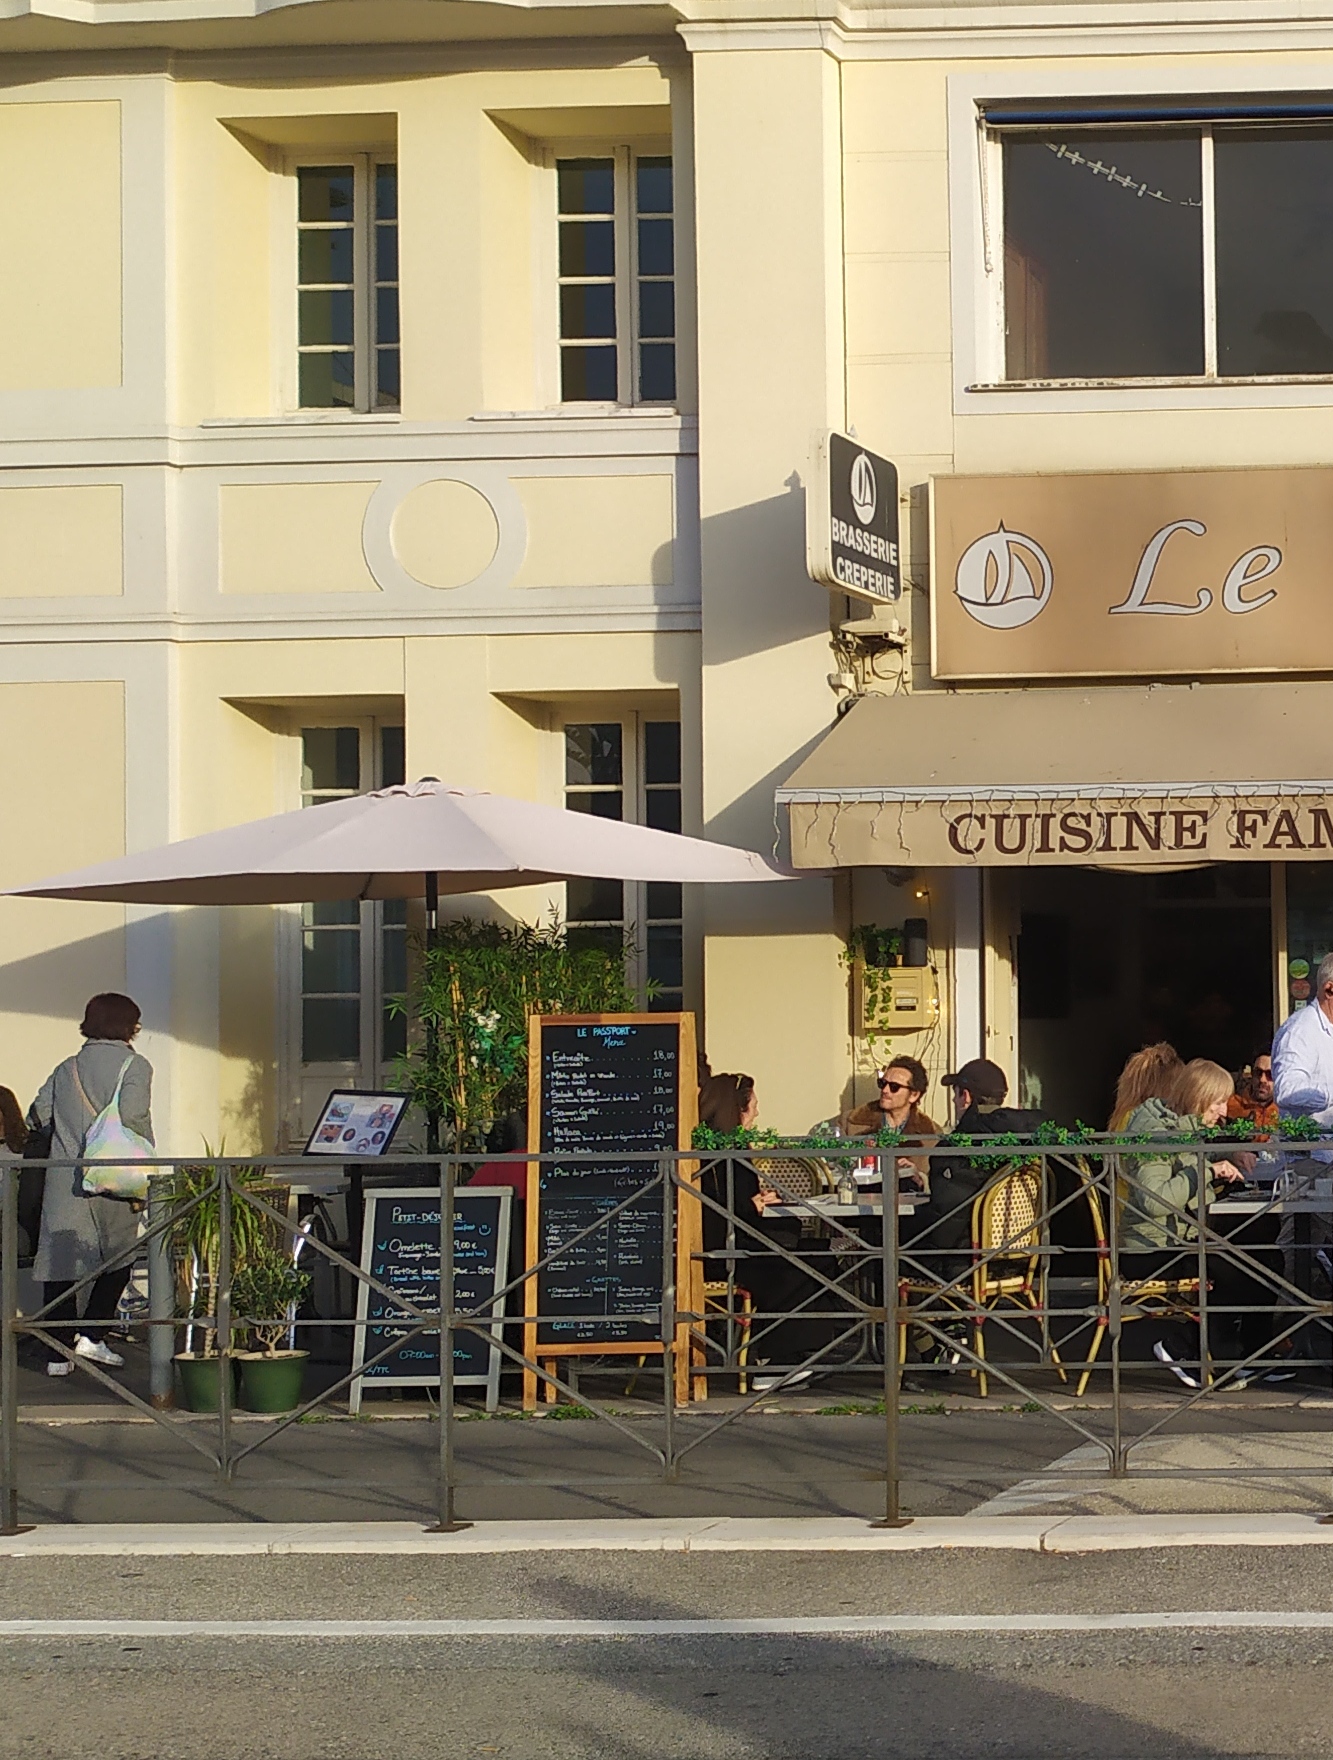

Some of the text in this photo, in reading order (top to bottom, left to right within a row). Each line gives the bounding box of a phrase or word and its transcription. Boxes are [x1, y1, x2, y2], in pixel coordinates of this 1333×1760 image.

[832, 516, 897, 567] BRASSERIE
[836, 556, 896, 599] CREPERIE
[1108, 518, 1283, 615] Le
[947, 809, 1208, 856] CUISINE
[577, 1028, 588, 1037] LE
